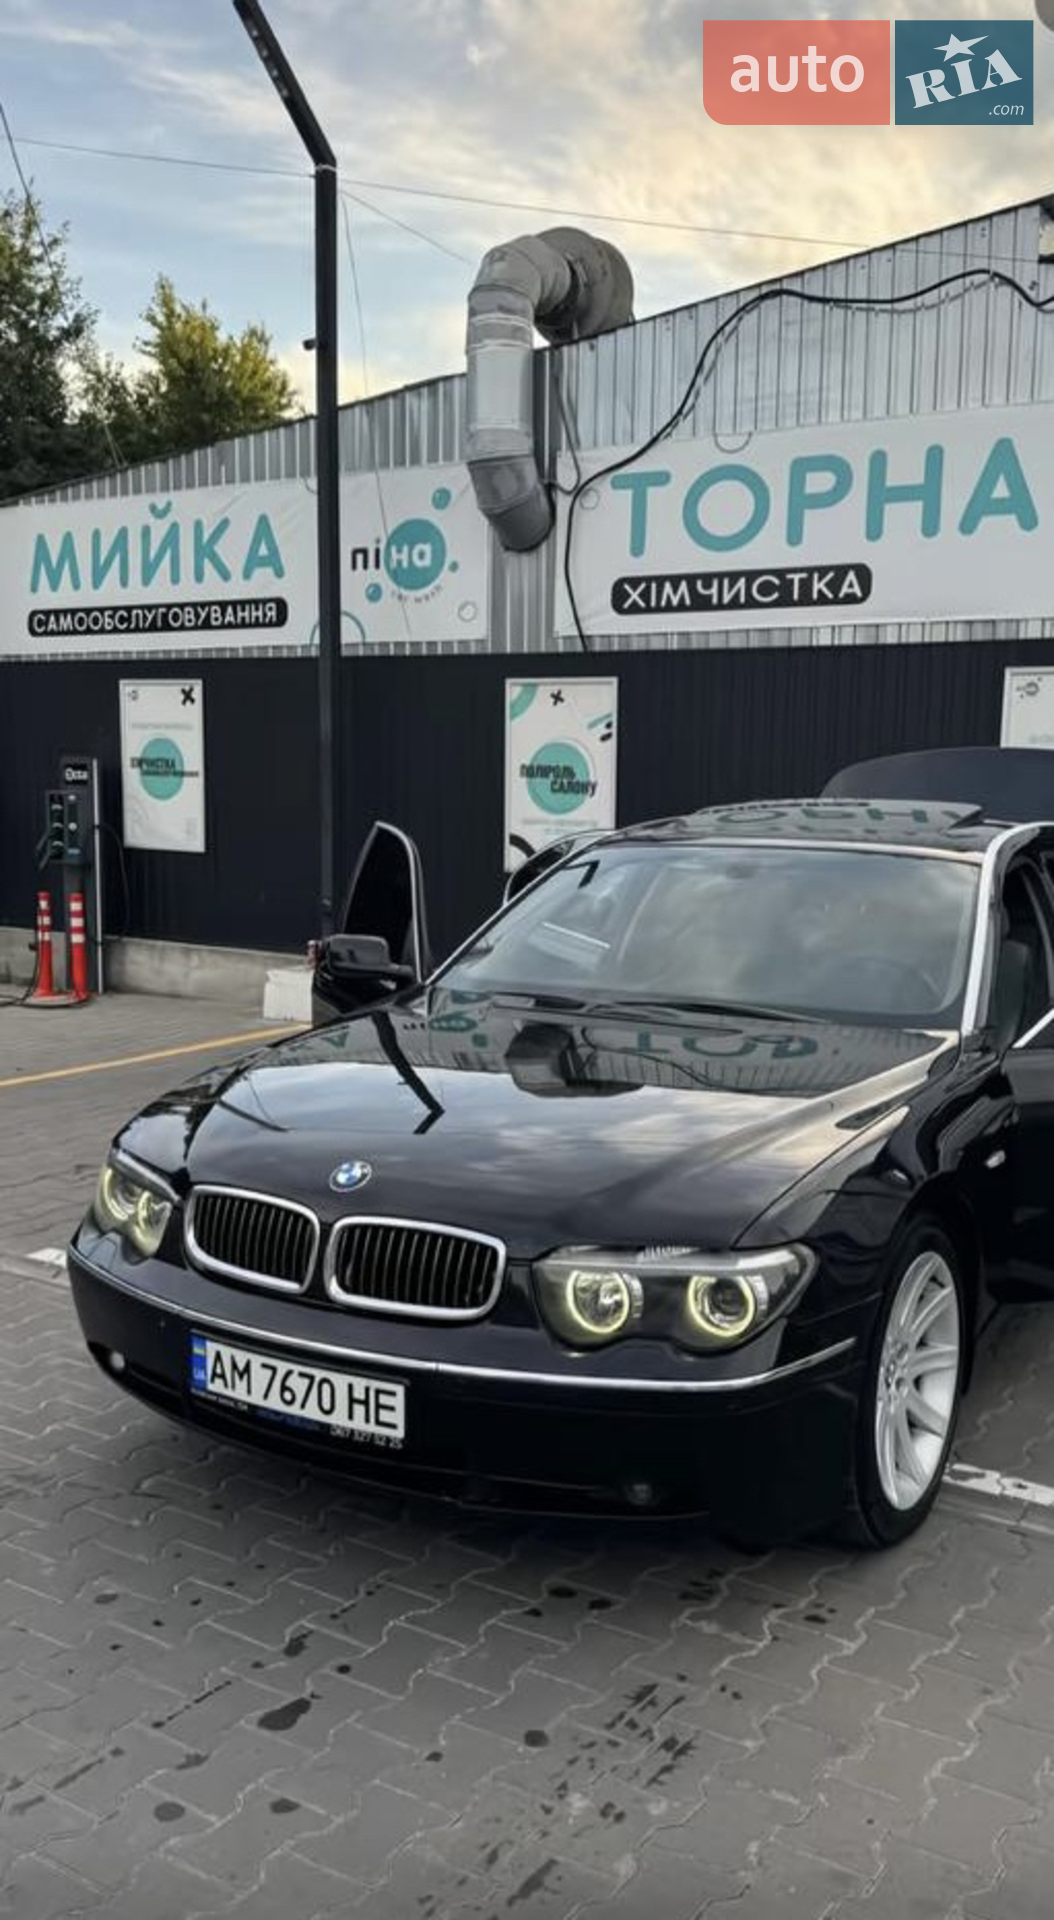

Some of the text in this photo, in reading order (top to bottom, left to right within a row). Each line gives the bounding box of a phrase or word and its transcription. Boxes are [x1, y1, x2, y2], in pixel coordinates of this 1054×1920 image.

[610, 437, 1039, 558] ТОРНА
[30, 500, 285, 593] МИЙКА
[32, 602, 278, 633] САМООБСЛУГОВУВАННЯ
[622, 569, 864, 610] ХІМЧИСТКА
[210, 1350, 252, 1396] AM
[260, 1363, 336, 1416] 7670
[347, 1383, 399, 1430] HE
